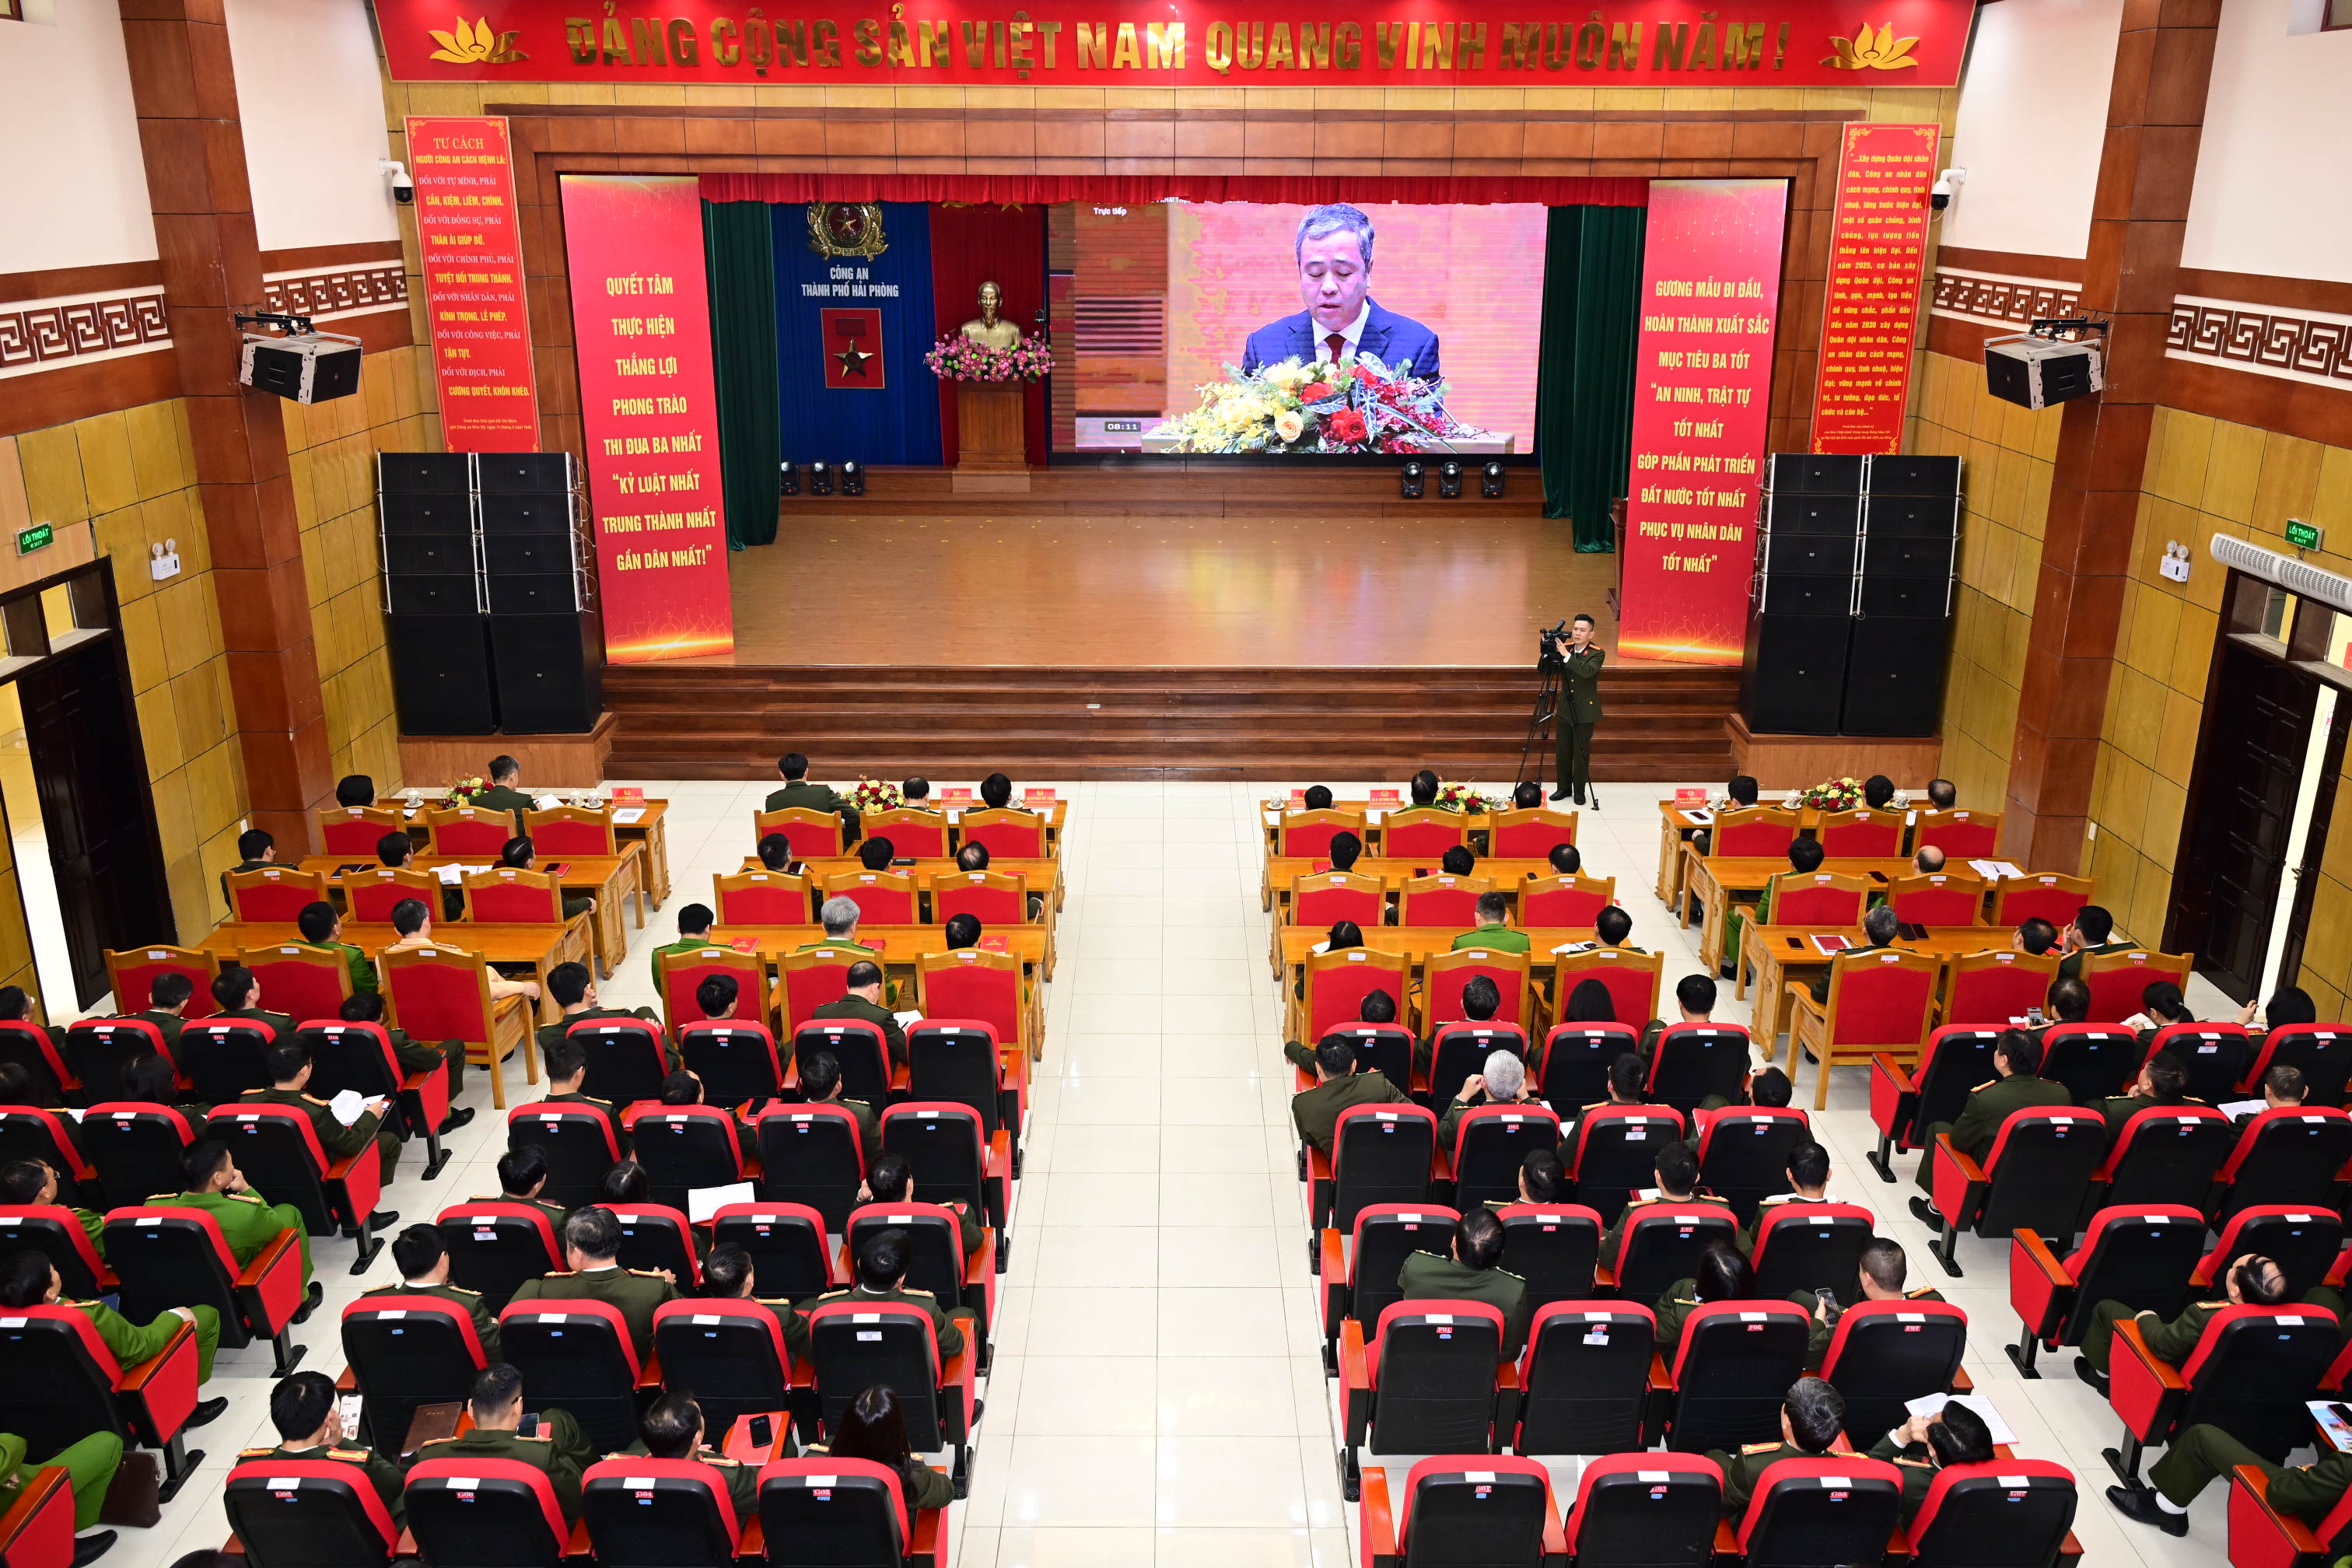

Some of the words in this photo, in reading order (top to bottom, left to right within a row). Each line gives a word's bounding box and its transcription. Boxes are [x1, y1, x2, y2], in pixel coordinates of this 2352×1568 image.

[565, 1, 701, 66] ĐẢNG
[711, 7, 841, 76] CỘNG
[855, 3, 950, 68] SẢN
[961, 10, 1062, 79] VIỆT
[1076, 22, 1186, 69] NAM
[1206, 22, 1362, 75] QUANG
[1376, 22, 1486, 70] VINH
[1500, 11, 1643, 70] MUÔN
[1653, 11, 1766, 70] NĂM
[433, 136, 450, 149] TƯ
[452, 135, 485, 149] CÁCH
[419, 174, 432, 185] ĐỐI
[432, 175, 446, 185] VỚI
[446, 177, 457, 187] TỰ
[457, 176, 478, 186] MÌNH,
[479, 174, 496, 185] PHẢI
[443, 194, 462, 208] KIỆM,
[462, 194, 481, 207] LIÊM,
[481, 194, 504, 206] CHÍNH.
[1093, 207, 1111, 216] Trực
[1111, 206, 1127, 216] tiếp
[423, 214, 436, 224] ĐỐI
[437, 215, 450, 224] VỚI
[451, 213, 471, 224] ĐỒNG
[472, 216, 484, 226] SỰ,
[484, 214, 502, 225] PHẢI
[428, 253, 441, 263] ĐỐI
[442, 254, 455, 263] VỚI
[456, 254, 478, 263] CHÍNH
[479, 253, 496, 264] PHỦ,
[497, 253, 514, 264] PHẢI
[435, 271, 454, 285] TUYỆT
[455, 271, 467, 283] ĐỐI
[467, 273, 489, 283] TRUNG
[489, 271, 513, 283] THÀNH.
[830, 264, 854, 280] CÔNG
[856, 268, 869, 280] AN
[606, 271, 644, 297] QUYẾT
[646, 274, 674, 294] TÂM
[801, 282, 830, 296] THÀNH
[832, 281, 850, 297] PHỐ
[852, 281, 866, 297] HẢI
[869, 282, 899, 297] PHÒNG
[1656, 279, 1692, 297] GƯƠNG
[1696, 275, 1721, 297] MẪU
[1724, 282, 1735, 298] ĐI
[1738, 276, 1763, 299] ĐẦU,
[439, 310, 456, 321] KÍNH
[456, 311, 480, 323] TRỌNG,
[489, 310, 507, 321] PHÉP.
[611, 316, 643, 339] THỰC
[646, 313, 675, 338] HIỆN
[1644, 313, 1675, 332] HOÀN
[1678, 313, 1713, 333] THÀNH
[1715, 313, 1745, 334] XUẤT
[1747, 312, 1769, 334] SẮC
[437, 329, 450, 338] ĐỐI
[450, 330, 464, 339] VỚI
[464, 330, 484, 339] CÔNG
[485, 330, 503, 341] VIỆC,
[504, 329, 521, 339] PHẢI
[615, 352, 656, 376] THẮNG
[659, 355, 677, 378] LỢI
[1658, 352, 1683, 370] MỤC
[1686, 349, 1710, 368] TIÊU
[1712, 353, 1727, 369] BA
[1731, 348, 1750, 369] TỐT
[448, 386, 471, 396] CƯƠNG
[471, 384, 492, 397] QUYẾT,
[492, 385, 511, 396] KHÔN
[511, 385, 530, 396] KHÉO.
[1674, 387, 1703, 404] NINH,
[1707, 385, 1734, 407] TRẬT
[1736, 387, 1752, 408] TỰ
[612, 397, 654, 416] PHONG
[656, 394, 687, 414] TRÀO
[1674, 416, 1693, 437] TỐT
[1695, 418, 1724, 438] NHẤT
[603, 439, 623, 456] THI
[625, 437, 650, 454] ĐUA
[652, 436, 669, 453] BA
[671, 429, 702, 453] NHẤT
[1637, 451, 1659, 470] GÓP
[1661, 450, 1691, 471] PHẦN
[1693, 454, 1722, 472] PHÁT
[1724, 453, 1755, 474] TRIỂN
[638, 472, 667, 495] LUẬT
[669, 468, 700, 491] NHẤT
[1641, 484, 1662, 503] ĐẤT
[1664, 487, 1693, 505] NƯỚC
[1696, 486, 1715, 506] TỐT
[1717, 488, 1746, 508] NHẤT
[602, 515, 642, 534] TRUNG
[644, 510, 684, 530] THÀNH
[686, 506, 716, 528] NHẤT
[1640, 521, 1668, 540] PHỤC
[1671, 523, 1685, 541] VỤ
[1687, 522, 1717, 540] NHÂN
[1720, 523, 1742, 541] DÂN
[617, 548, 642, 571] GẦN
[644, 549, 669, 569] DÂN
[1662, 551, 1682, 571] TỐT
